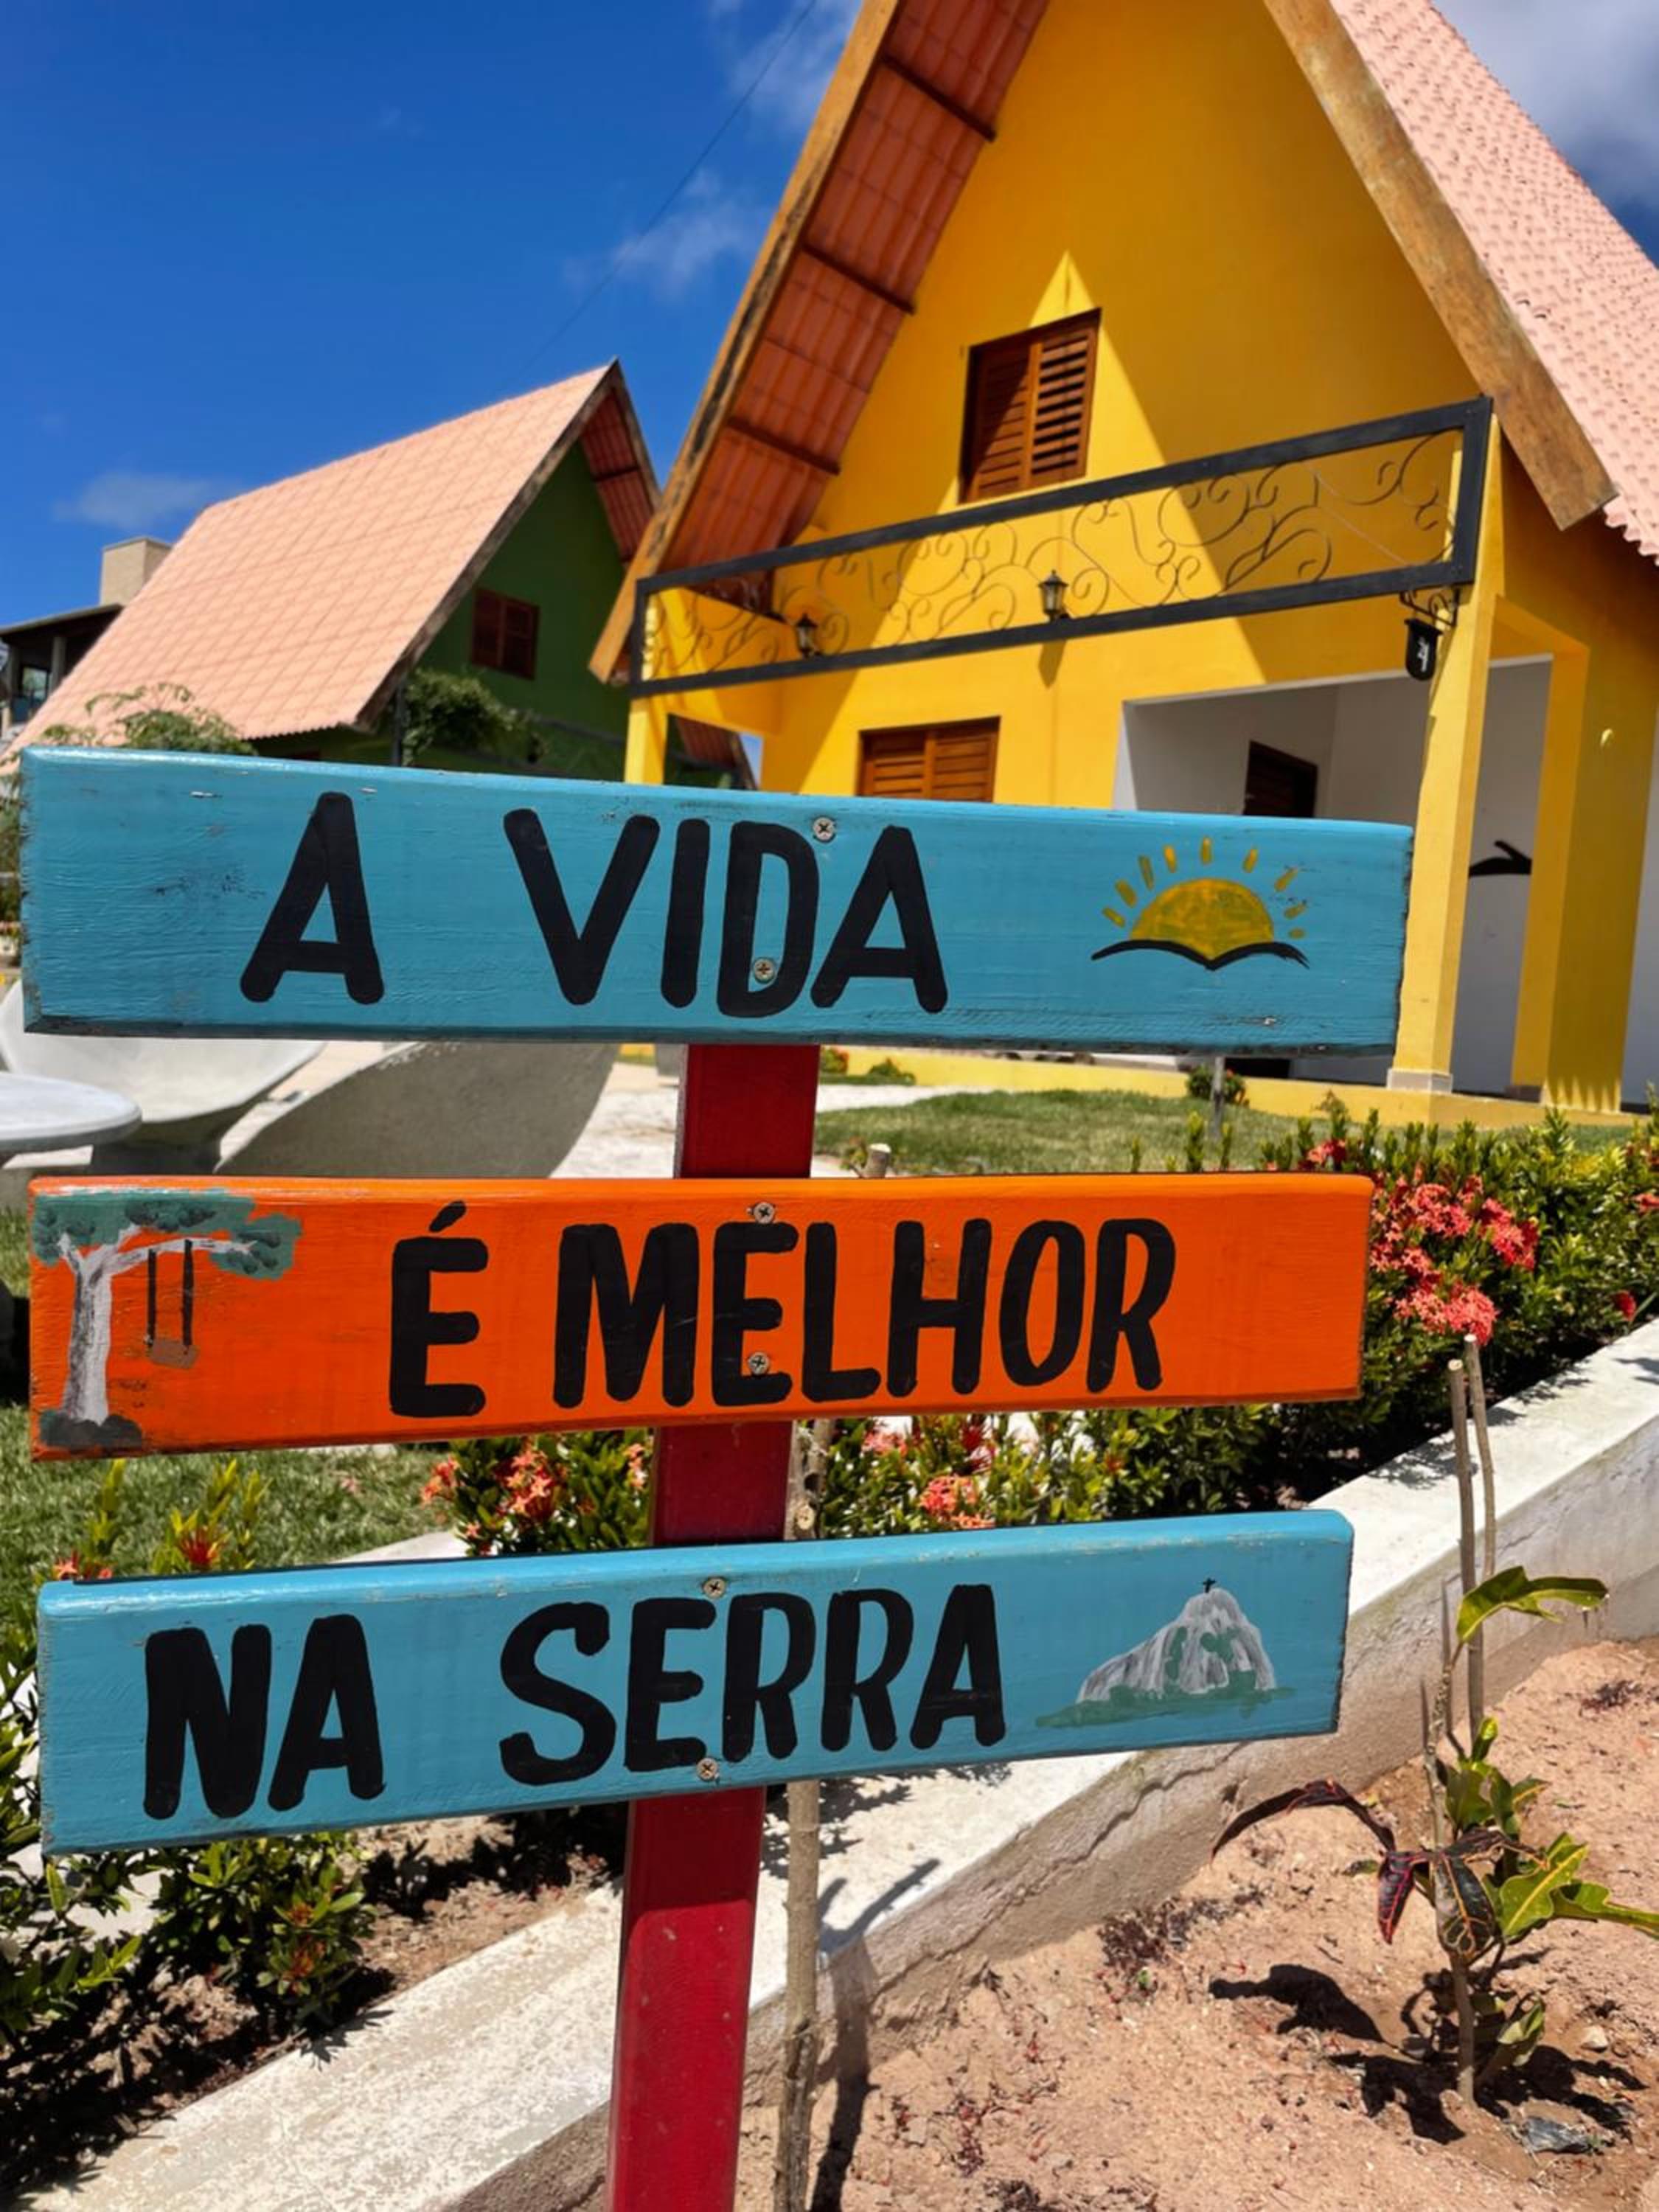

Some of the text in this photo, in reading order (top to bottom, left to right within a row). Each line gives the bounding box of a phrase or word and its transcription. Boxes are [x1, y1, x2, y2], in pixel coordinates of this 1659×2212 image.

[240, 792, 949, 1019] A VIDA
[389, 1202, 1175, 1418] É MELHOR
[143, 1584, 1007, 1821] NA SERRA
